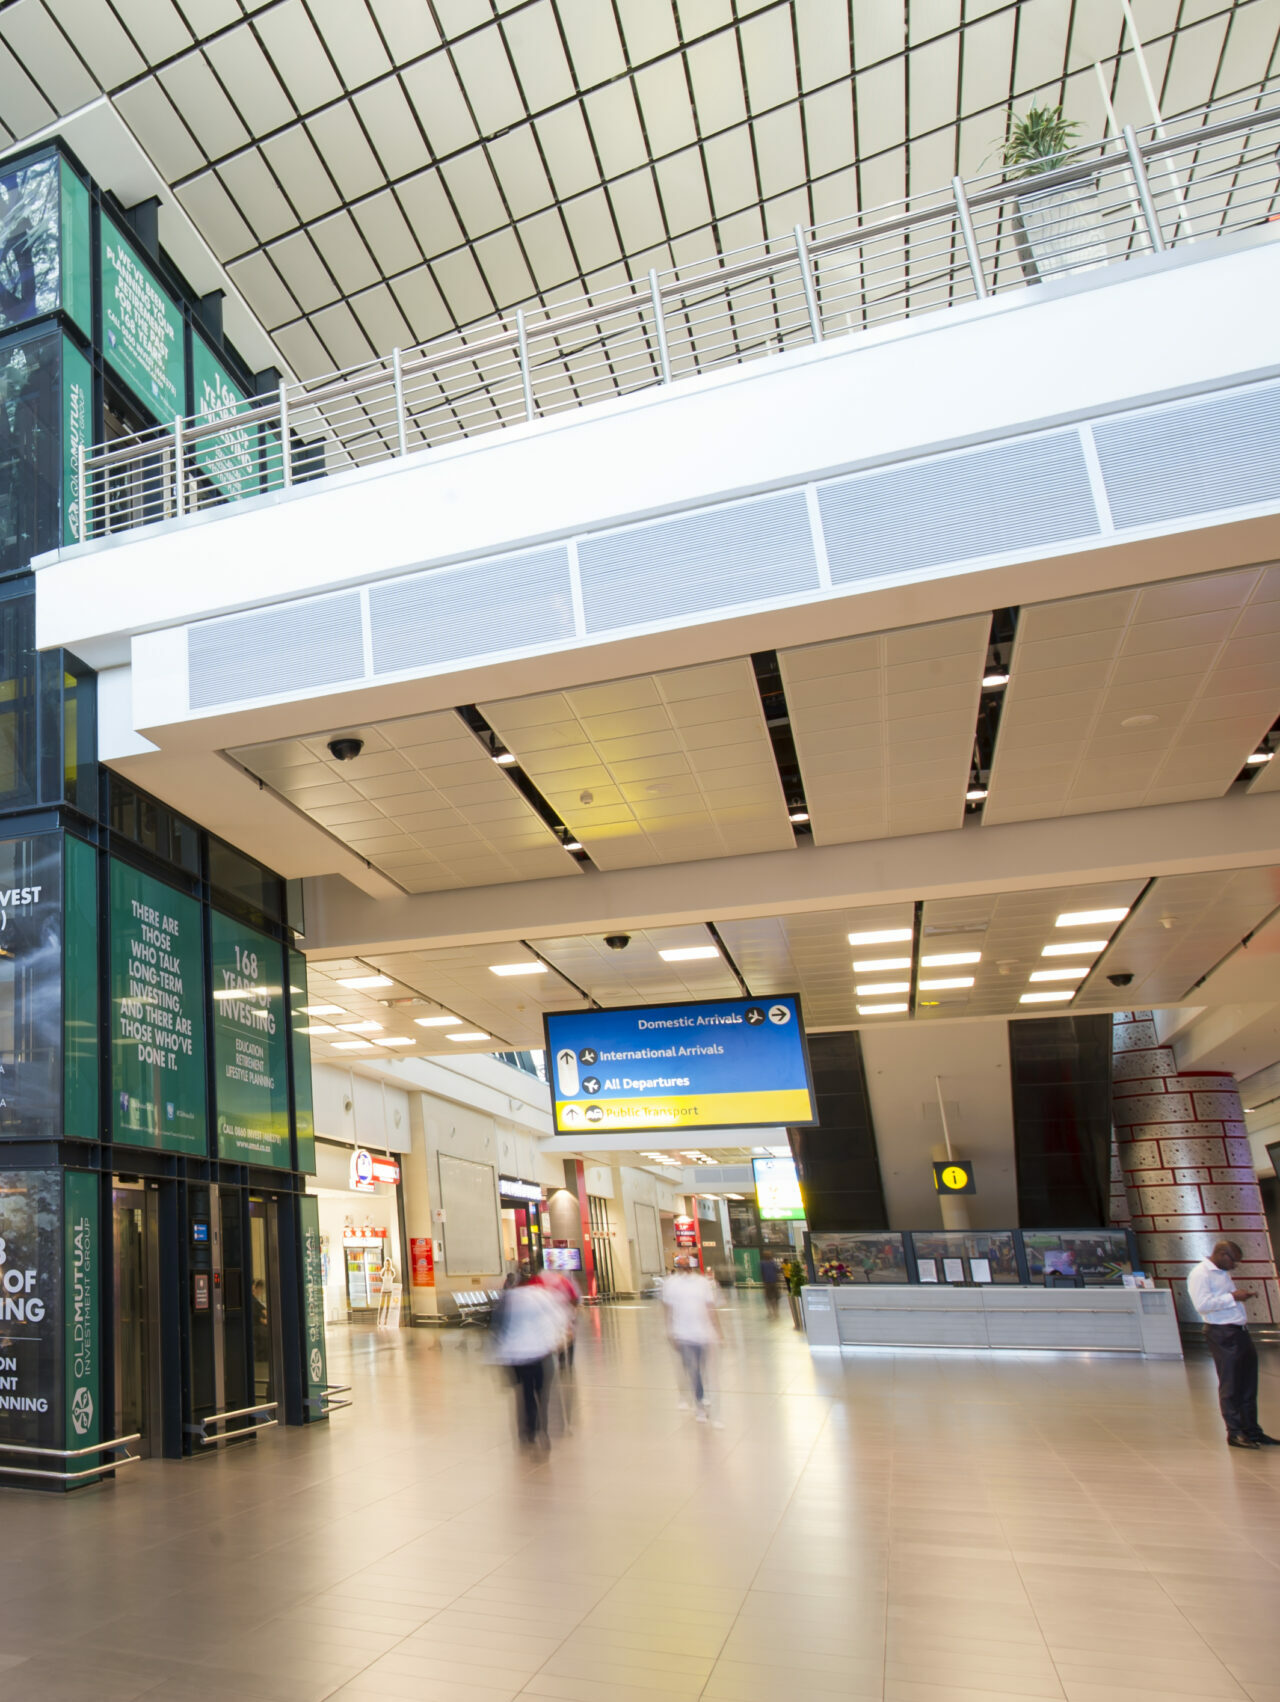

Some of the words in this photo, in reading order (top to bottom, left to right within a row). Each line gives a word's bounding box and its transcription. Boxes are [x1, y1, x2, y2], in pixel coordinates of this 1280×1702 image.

[106, 245, 151, 310] PLANNING
[152, 303, 175, 341] YOUR
[118, 245, 144, 288] WE'VE
[145, 282, 165, 315] BEEN
[107, 309, 121, 330] CALL
[115, 285, 132, 316] FOR
[134, 308, 148, 336] THE
[150, 329, 168, 360] PAST
[118, 275, 164, 341] RETIREMENT
[120, 306, 136, 335] 168
[132, 900, 159, 928] THERE
[162, 916, 179, 936] ARE
[141, 924, 171, 951] THOSE
[131, 940, 156, 965] WHO
[159, 953, 180, 974] TALK
[234, 946, 258, 979] 168
[129, 959, 183, 995] LONG-TERM
[222, 969, 255, 1000] YEARS
[130, 980, 183, 1015] INVESTING,
[120, 998, 143, 1021] AND
[146, 1006, 173, 1029] THERE
[175, 1016, 192, 1036] ARE
[220, 1000, 276, 1035] INVESTING
[638, 1015, 694, 1030] Domestic
[697, 1012, 743, 1026] Arrivals
[121, 1018, 152, 1043] THOSE
[155, 1029, 192, 1055] WHO'VE
[235, 1038, 263, 1057] EDUCATION
[600, 1046, 676, 1061] International
[679, 1043, 724, 1056] Arrivals
[138, 1044, 166, 1068] DONE
[168, 1053, 178, 1071] IT.
[235, 1053, 264, 1072] RETIREMENT
[225, 1065, 248, 1081] LIFESTYLE
[249, 1070, 274, 1089] PLANNING
[604, 1078, 620, 1090] All
[623, 1076, 690, 1091] Departures
[606, 1107, 640, 1118] Public
[642, 1105, 699, 1118] Transport
[84, 1217, 92, 1272] GROUP
[4, 1269, 37, 1293] OF
[74, 1217, 84, 1378] OLDMUTUAL
[84, 1277, 92, 1375] INVESTMENT
